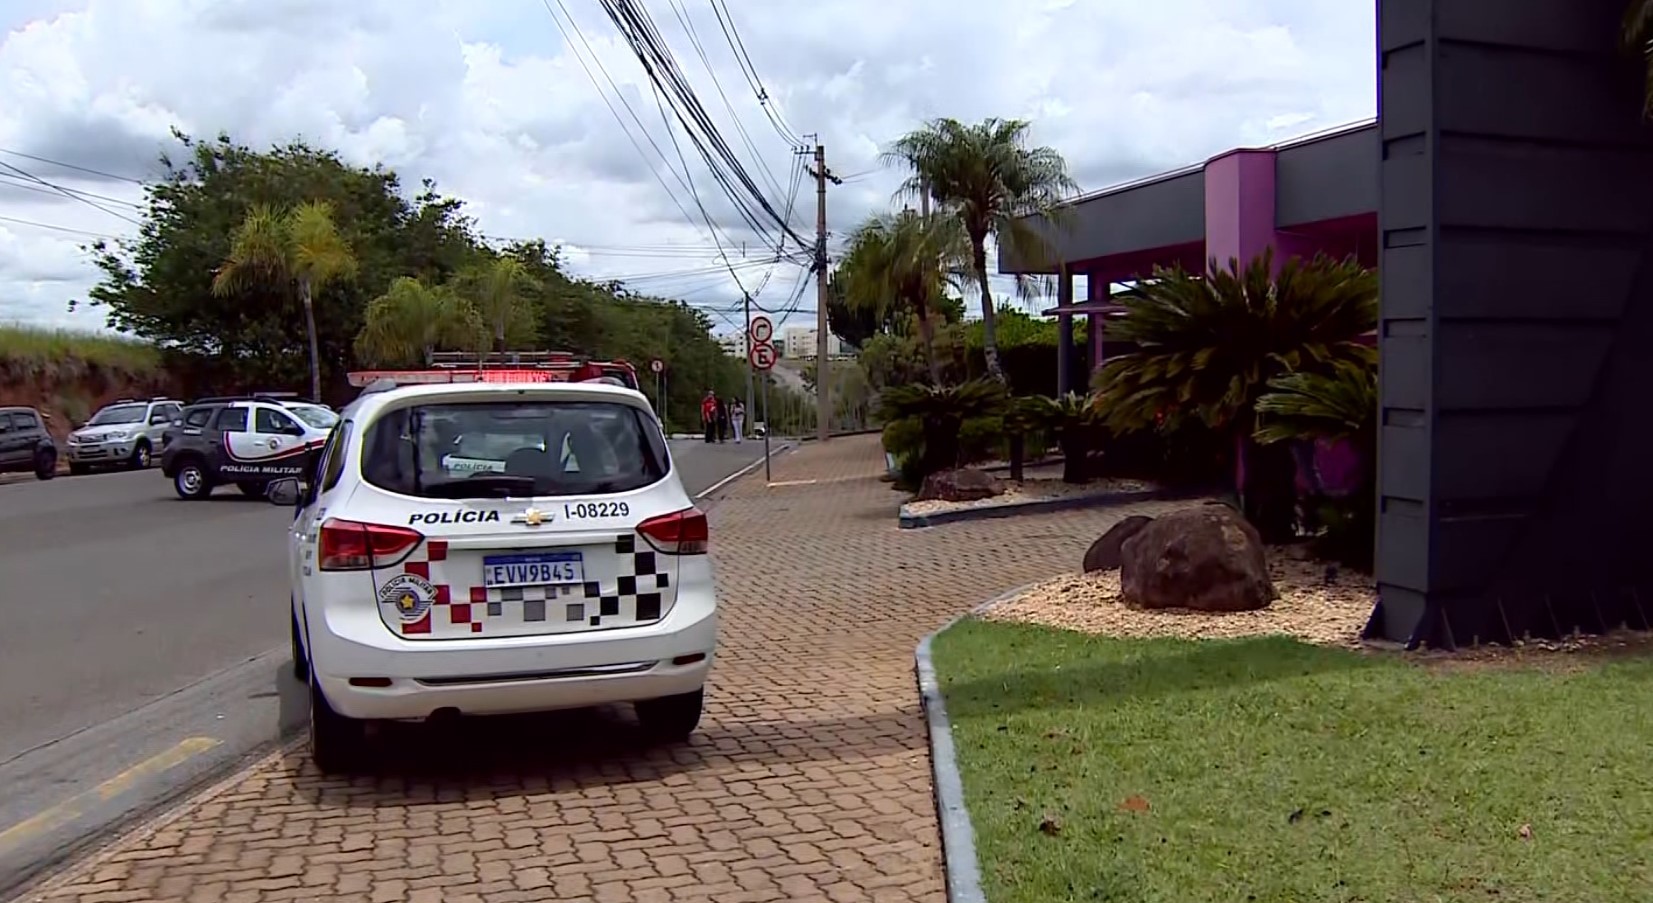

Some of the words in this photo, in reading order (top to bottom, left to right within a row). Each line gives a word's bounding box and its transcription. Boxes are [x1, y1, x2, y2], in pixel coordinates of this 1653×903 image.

[220, 464, 259, 473] POLÍCIA
[262, 466, 302, 474] MILITAR
[409, 509, 500, 525] POLÍCIA
[565, 501, 630, 519] I-08229
[494, 563, 574, 585] EVW9B45
